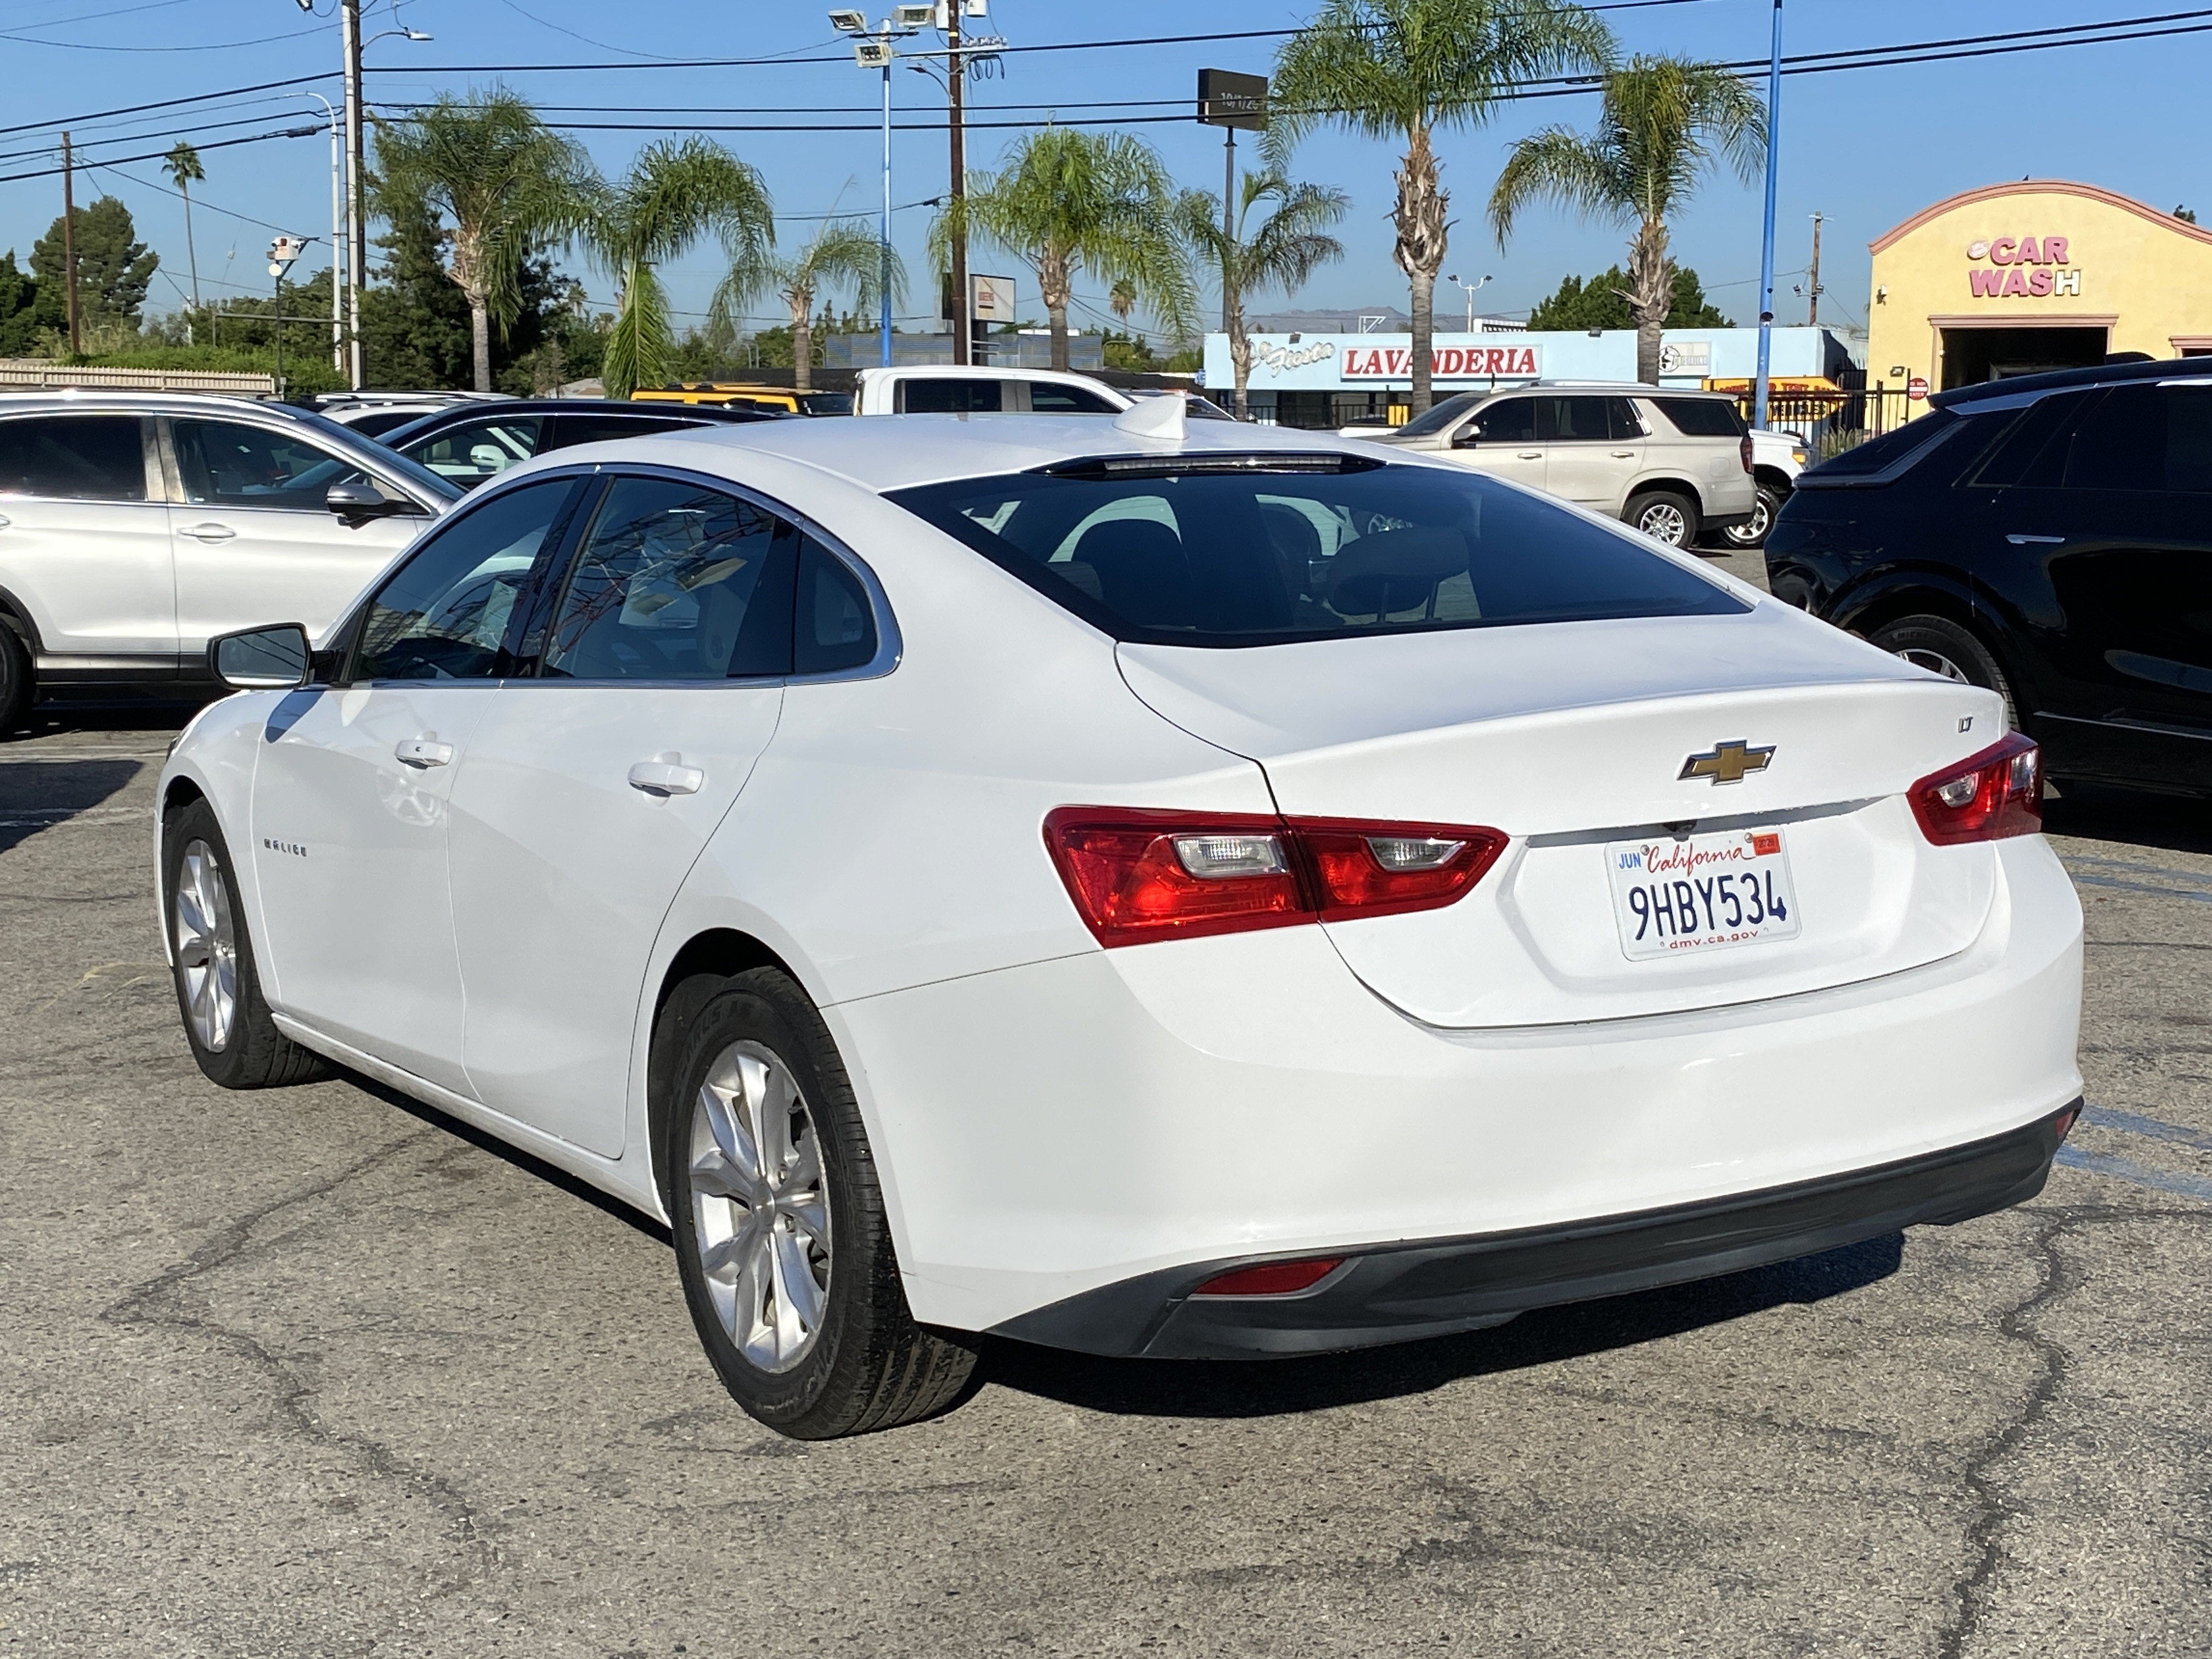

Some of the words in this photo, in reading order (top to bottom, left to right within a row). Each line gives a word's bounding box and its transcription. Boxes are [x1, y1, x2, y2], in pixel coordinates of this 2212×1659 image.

[1990, 236, 2069, 266] CAR
[1969, 268, 2081, 297] WASH
[1265, 341, 1336, 378] Fiesta
[1958, 716, 1973, 733] LT
[1618, 851, 1641, 870] JUN
[1647, 842, 1757, 877] California
[1628, 869, 1787, 941] 9HBY534
[1669, 929, 1759, 950] dmv.ca.gov
